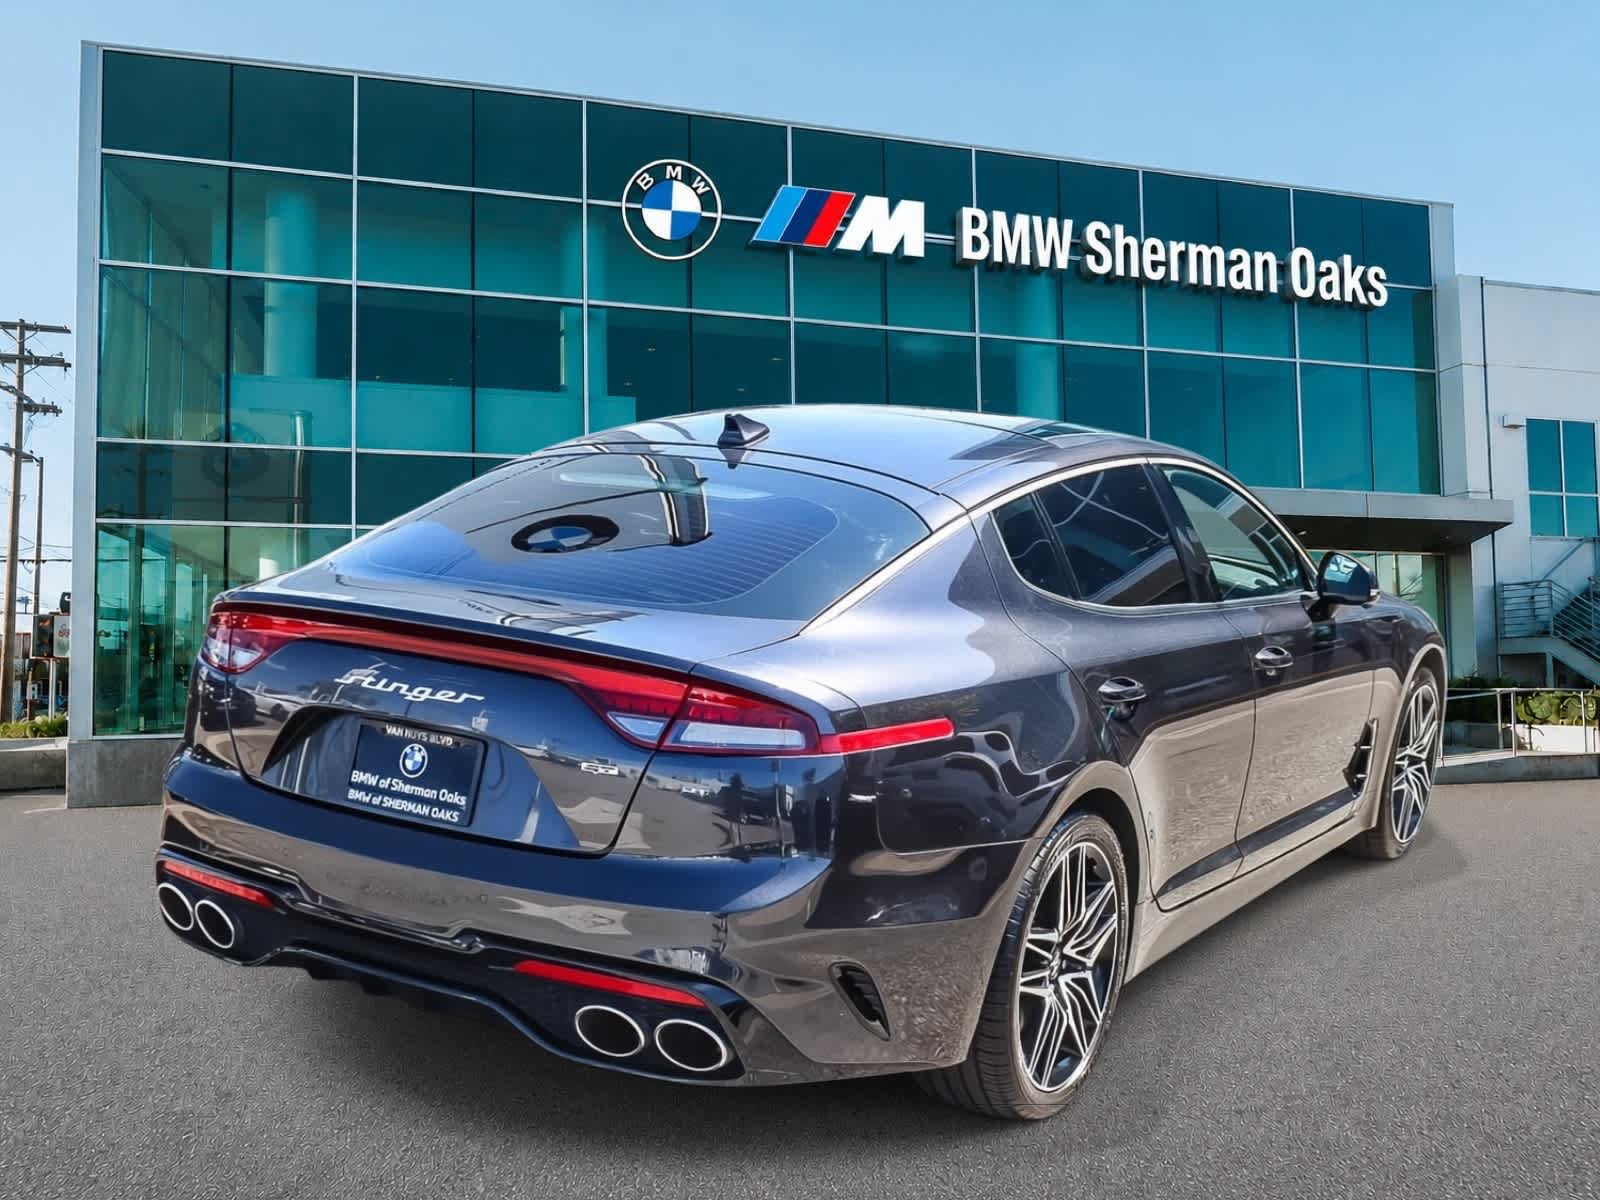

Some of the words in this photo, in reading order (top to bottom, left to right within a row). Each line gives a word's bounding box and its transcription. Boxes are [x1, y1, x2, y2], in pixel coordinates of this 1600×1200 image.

[636, 165, 711, 195] BMW
[836, 195, 925, 257] M
[960, 206, 1073, 270] BMW
[1084, 220, 1278, 294] Sherman
[1289, 246, 1388, 308] Oaks
[334, 668, 485, 703] Stinger
[385, 724, 404, 737] VAN
[404, 728, 427, 742] NUYS
[348, 788, 372, 804] BMW
[371, 795, 381, 806] of
[382, 796, 430, 816] SHERMAN
[431, 807, 460, 823] OAKS
[351, 770, 379, 787] BMW
[379, 777, 390, 789] of
[390, 778, 437, 800] Sherman
[439, 788, 467, 806] Oaks
